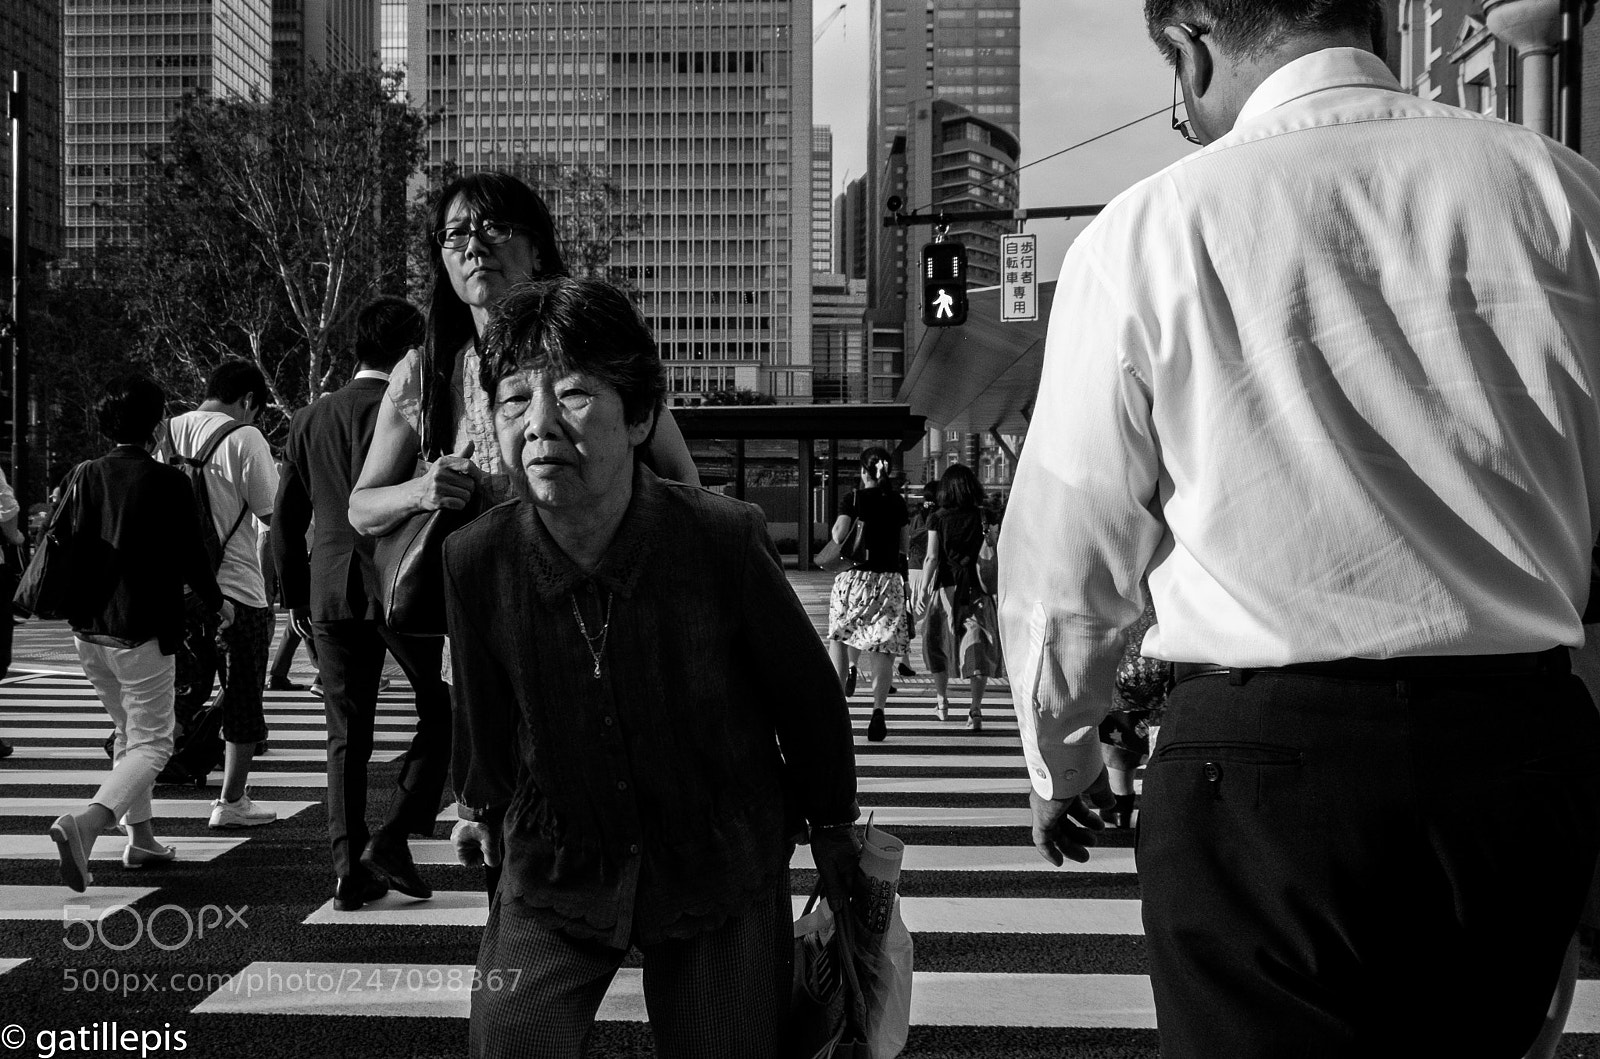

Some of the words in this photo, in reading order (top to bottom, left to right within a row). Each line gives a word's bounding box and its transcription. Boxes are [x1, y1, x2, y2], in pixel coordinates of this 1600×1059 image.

[1006, 242, 1019, 284] 自転車
[1020, 241, 1034, 284] 歩行者
[1013, 286, 1026, 314] 専用
